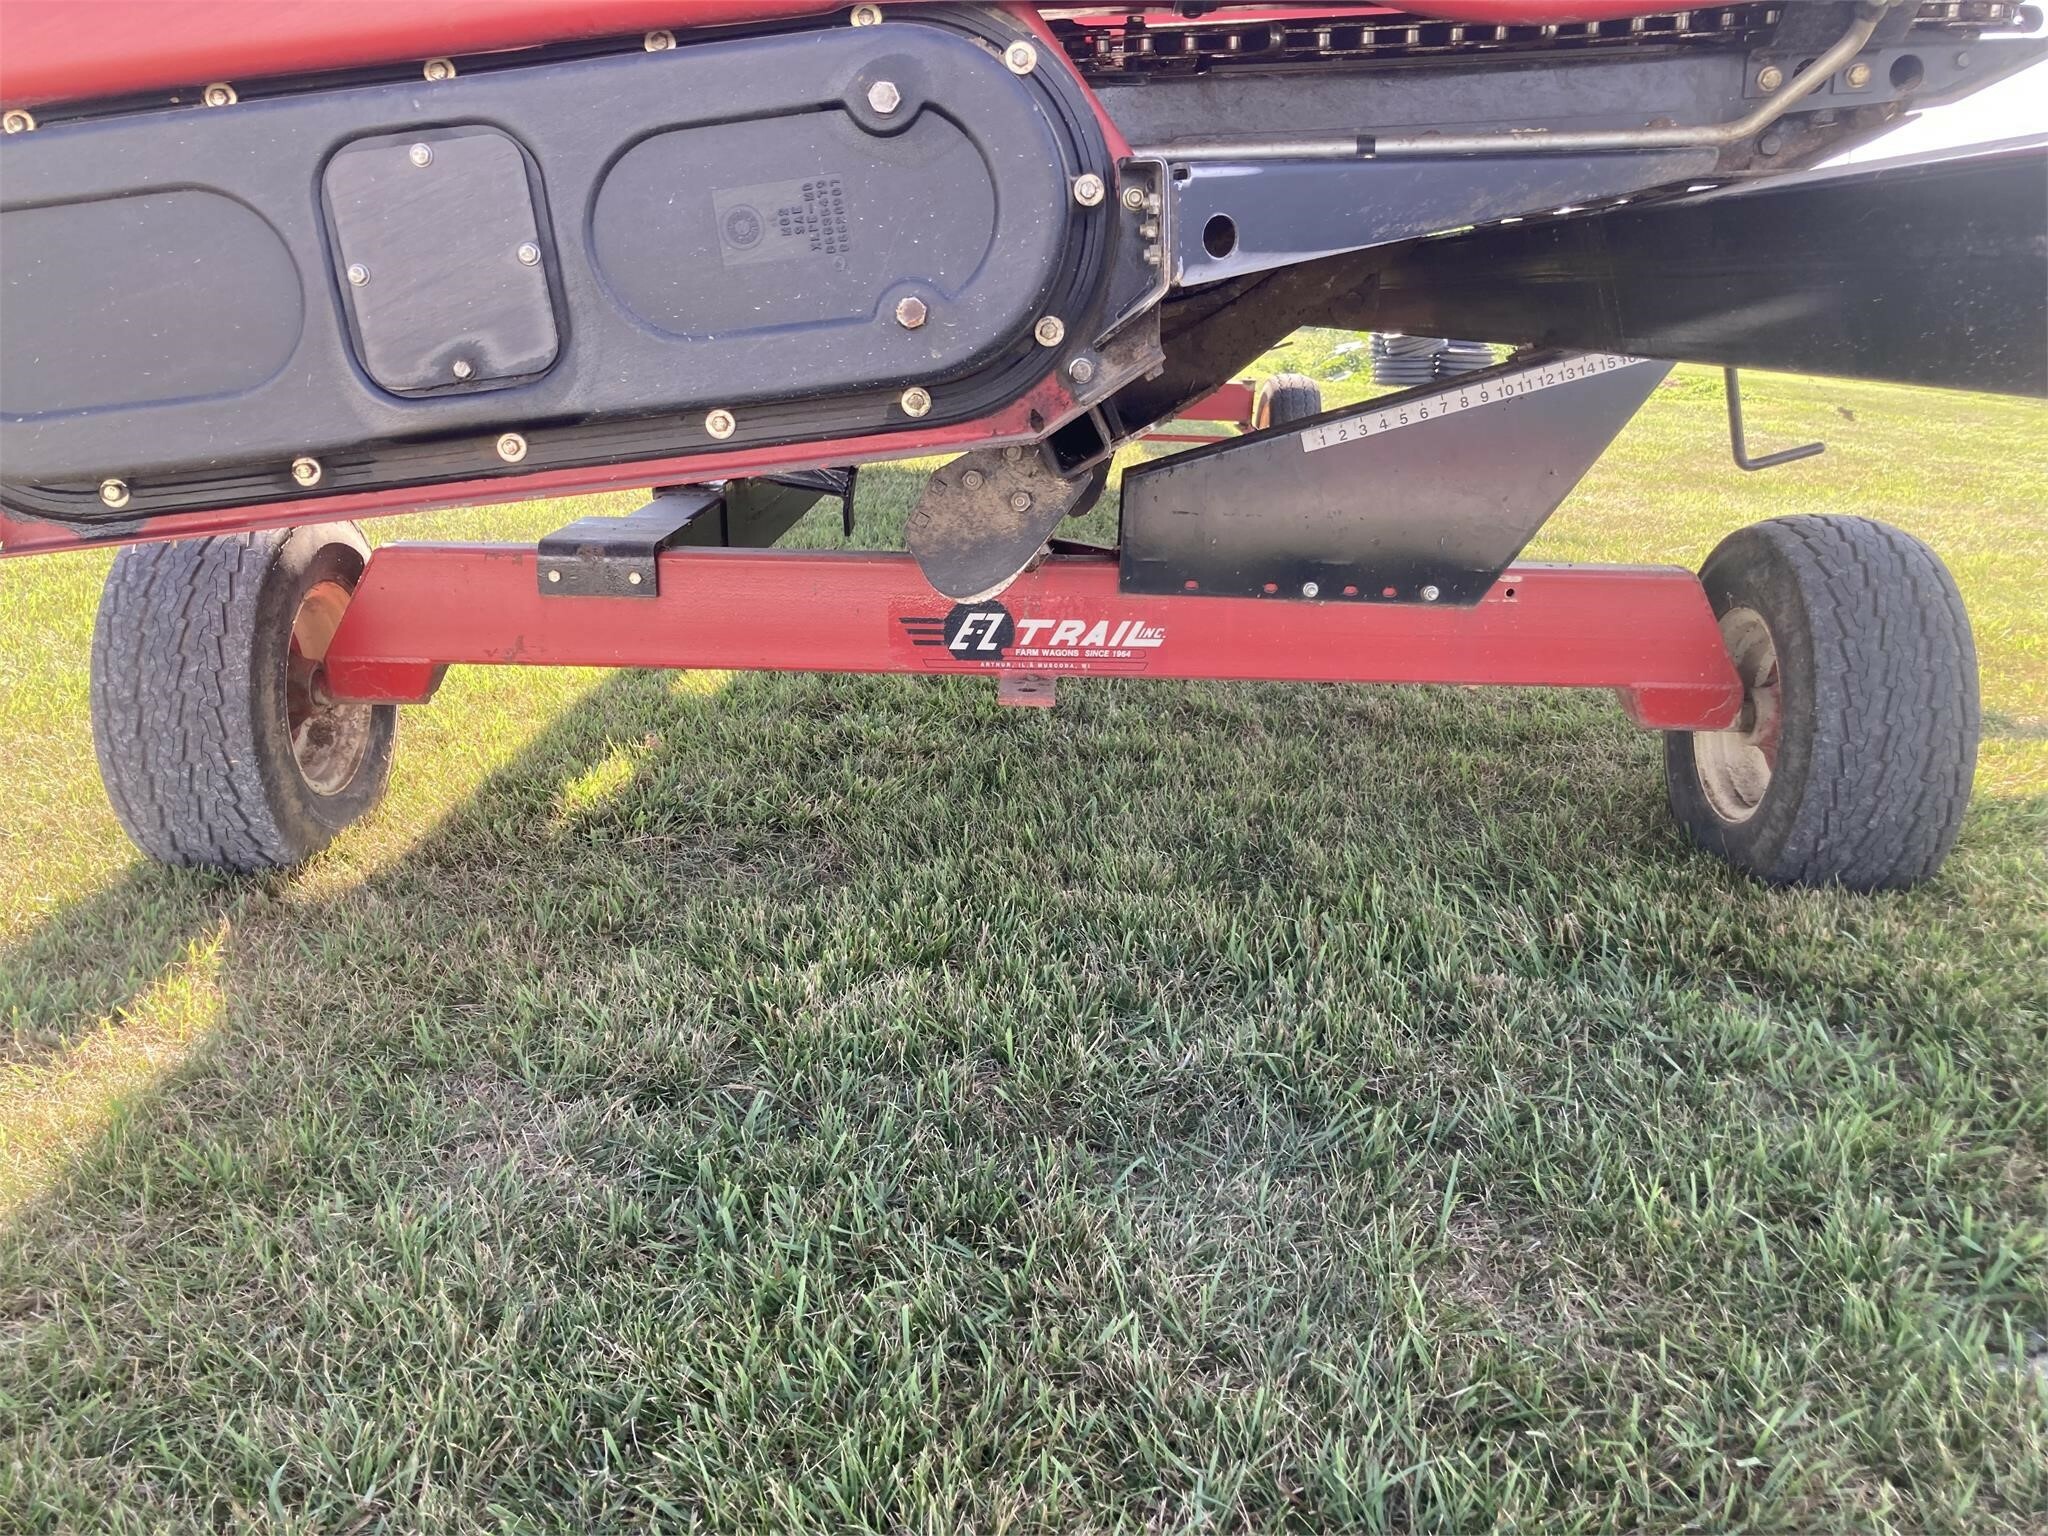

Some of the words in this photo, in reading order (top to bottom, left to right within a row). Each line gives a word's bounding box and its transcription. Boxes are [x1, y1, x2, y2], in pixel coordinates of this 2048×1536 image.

[1320, 434, 1327, 446] 1
[1338, 428, 1348, 441] 2
[1358, 423, 1368, 436] 3
[1379, 418, 1388, 431] 4
[1399, 412, 1409, 425] 5
[1419, 406, 1429, 420] 6
[1439, 401, 1448, 415] 7
[1460, 395, 1469, 409] 8
[1480, 390, 1489, 403] 9
[1497, 384, 1514, 398] 10
[1518, 378, 1533, 392] 11
[1538, 372, 1555, 387] 12
[1558, 367, 1576, 380] 13
[1578, 362, 1596, 376] 14
[1600, 357, 1616, 371] 15
[1016, 618, 1166, 648] TRAIL
[1137, 627, 1166, 639] INC.
[1015, 648, 1039, 657] FARM
[1041, 648, 1080, 658] WAGONS
[1084, 649, 1110, 658] SINCE
